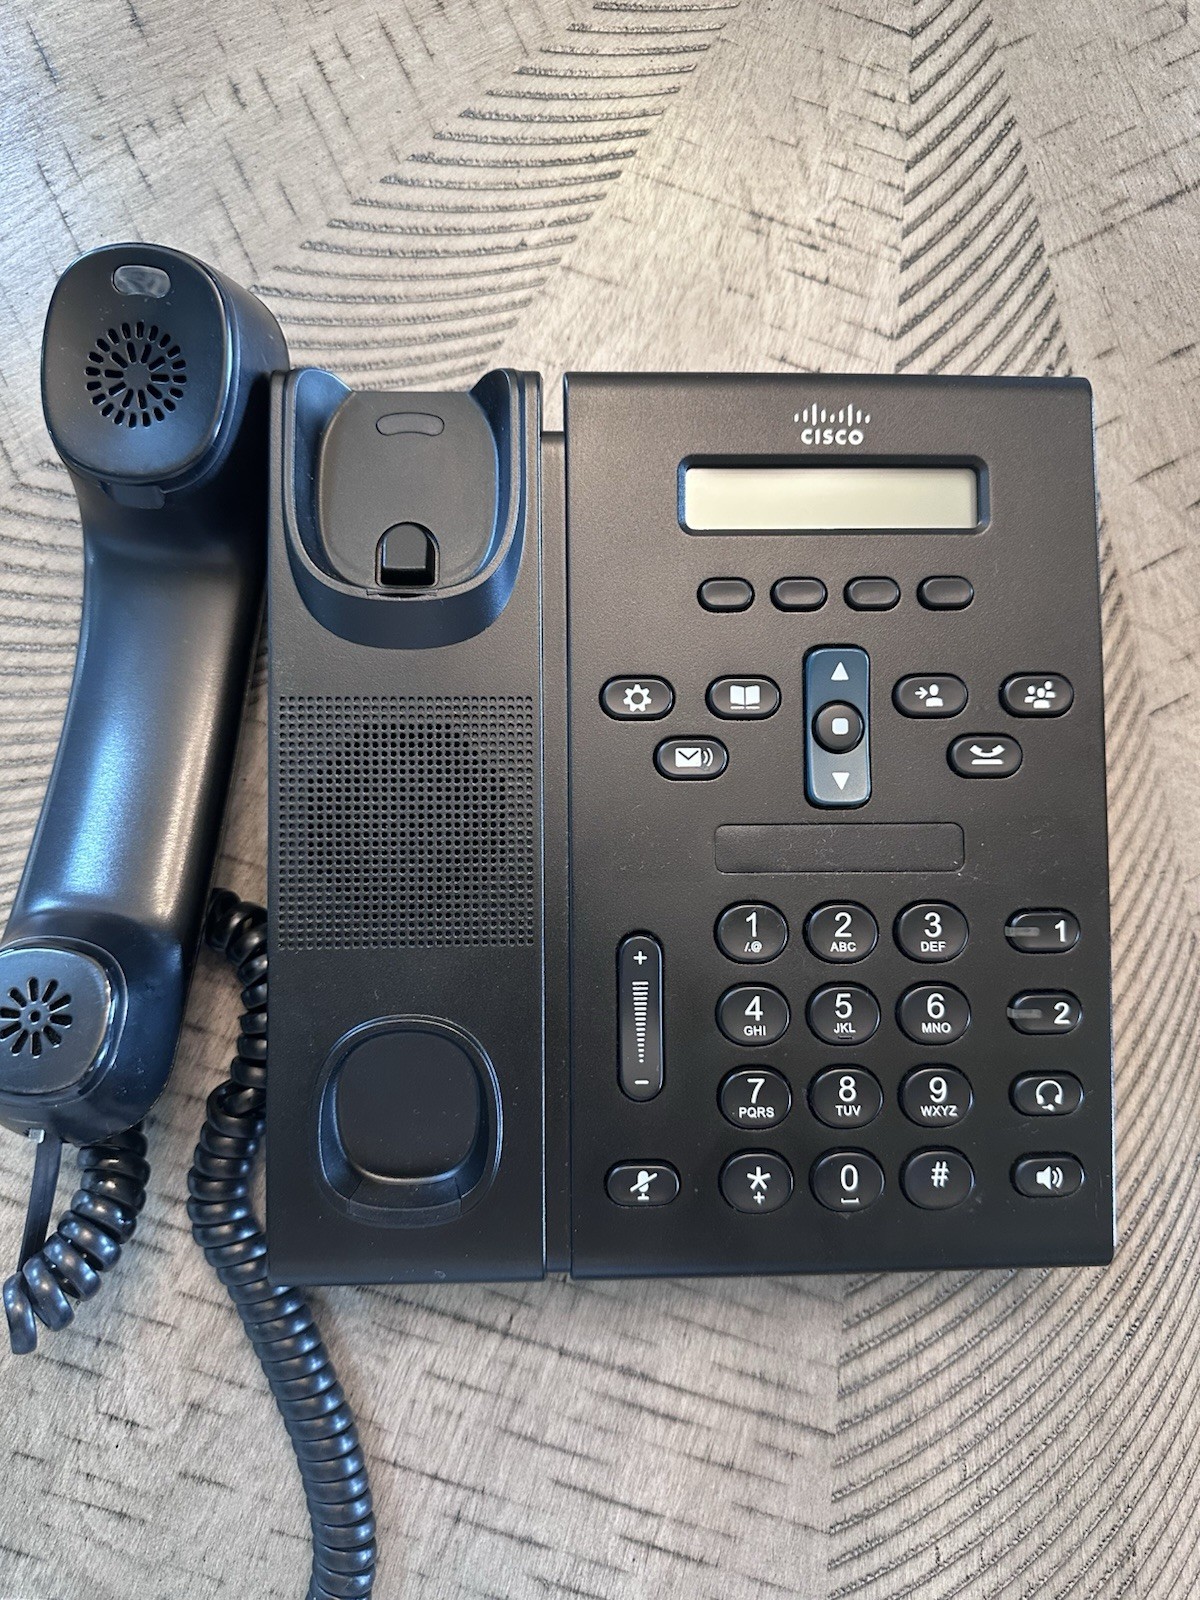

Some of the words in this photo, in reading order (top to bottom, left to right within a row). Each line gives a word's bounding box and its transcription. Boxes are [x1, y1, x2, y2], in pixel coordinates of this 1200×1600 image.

[745, 911, 757, 938] 1
[834, 911, 853, 938] 2
[924, 911, 943, 939] 3
[1054, 919, 1067, 943] 1
[829, 941, 857, 953] ABC
[920, 940, 947, 953] DEF
[744, 995, 764, 1022] 4
[834, 992, 853, 1019] 5
[926, 992, 945, 1020] 6
[1053, 1001, 1072, 1025] 2
[742, 1024, 767, 1037] GHI
[833, 1022, 857, 1034] JKL
[921, 1021, 952, 1034] MNO
[746, 1077, 765, 1104] 7
[838, 1075, 857, 1103] 8
[929, 1076, 948, 1104] 9
[738, 1106, 775, 1119] PQRS
[834, 1104, 862, 1117] TUV
[920, 1104, 958, 1117] WXYZ
[840, 1164, 859, 1192] 0
